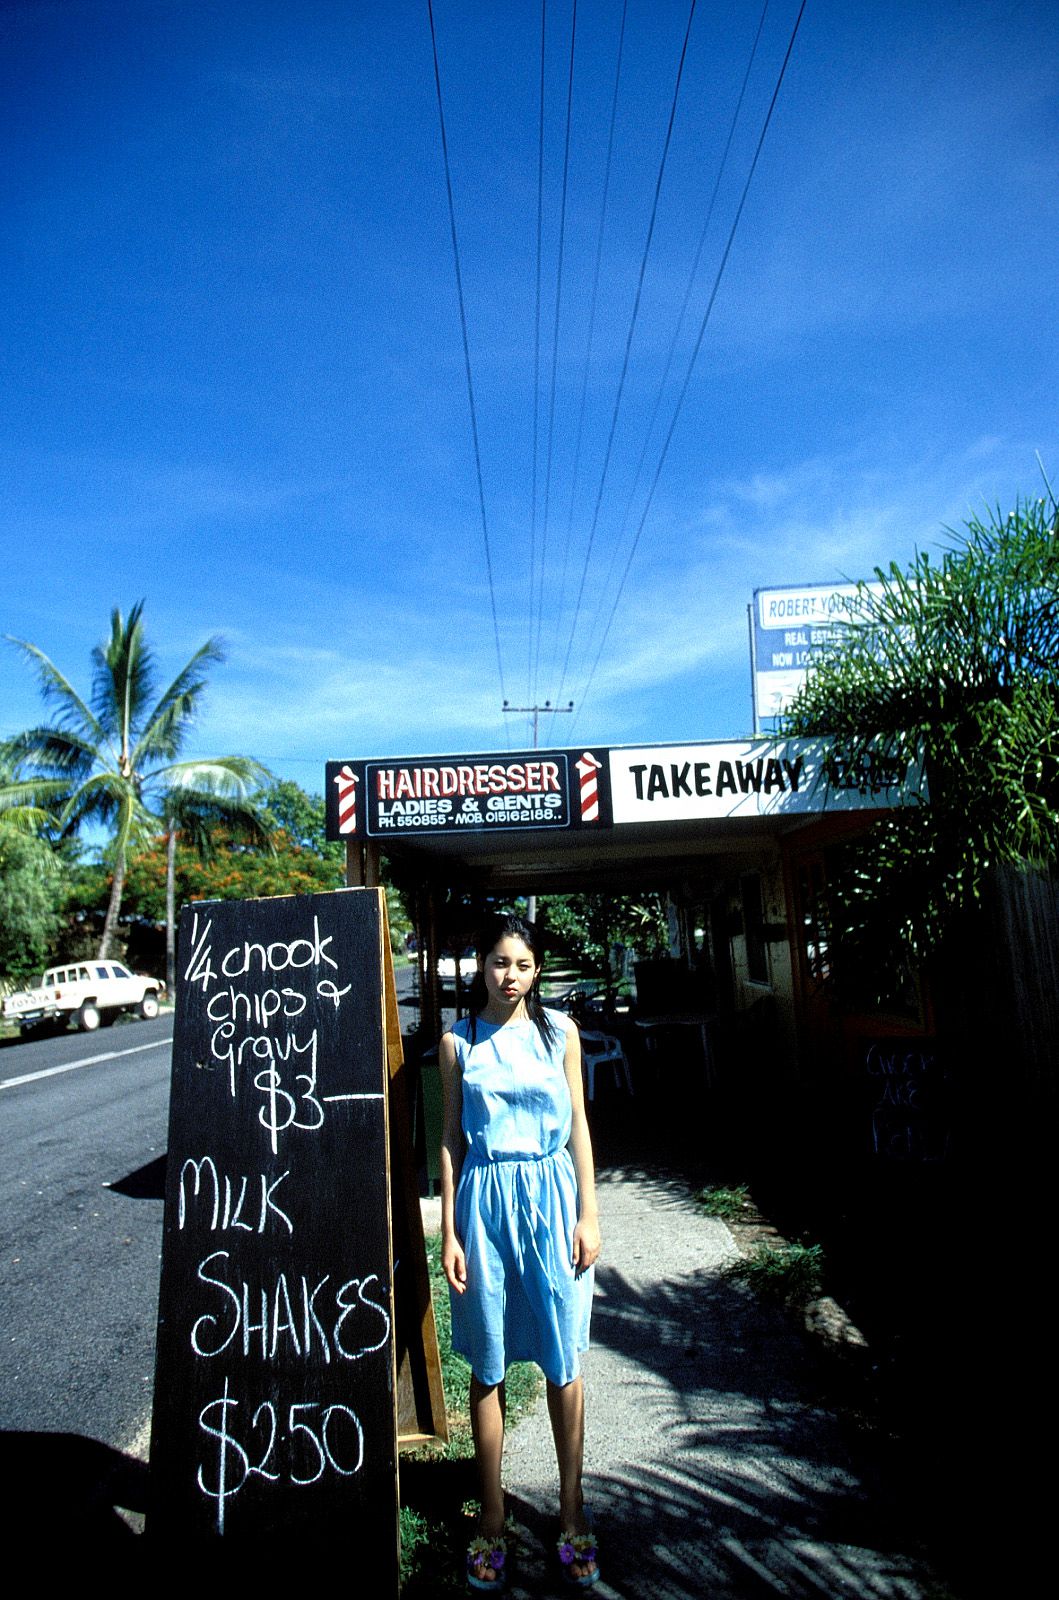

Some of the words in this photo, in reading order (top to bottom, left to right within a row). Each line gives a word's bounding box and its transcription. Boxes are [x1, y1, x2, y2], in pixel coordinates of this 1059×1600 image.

[769, 597, 817, 618] ROBERT
[784, 631, 809, 646] REAL
[772, 651, 794, 667] NOW
[377, 761, 562, 799] HAIRDRESSER
[629, 757, 803, 801] TAKEAWAY
[378, 799, 453, 817] LADIES
[461, 797, 480, 812] &
[486, 793, 562, 811] GENTS
[207, 986, 306, 1028] chips
[211, 1022, 317, 1097] Gravy
[179, 1156, 293, 1233] MILK
[190, 1251, 391, 1363] SHAKES
